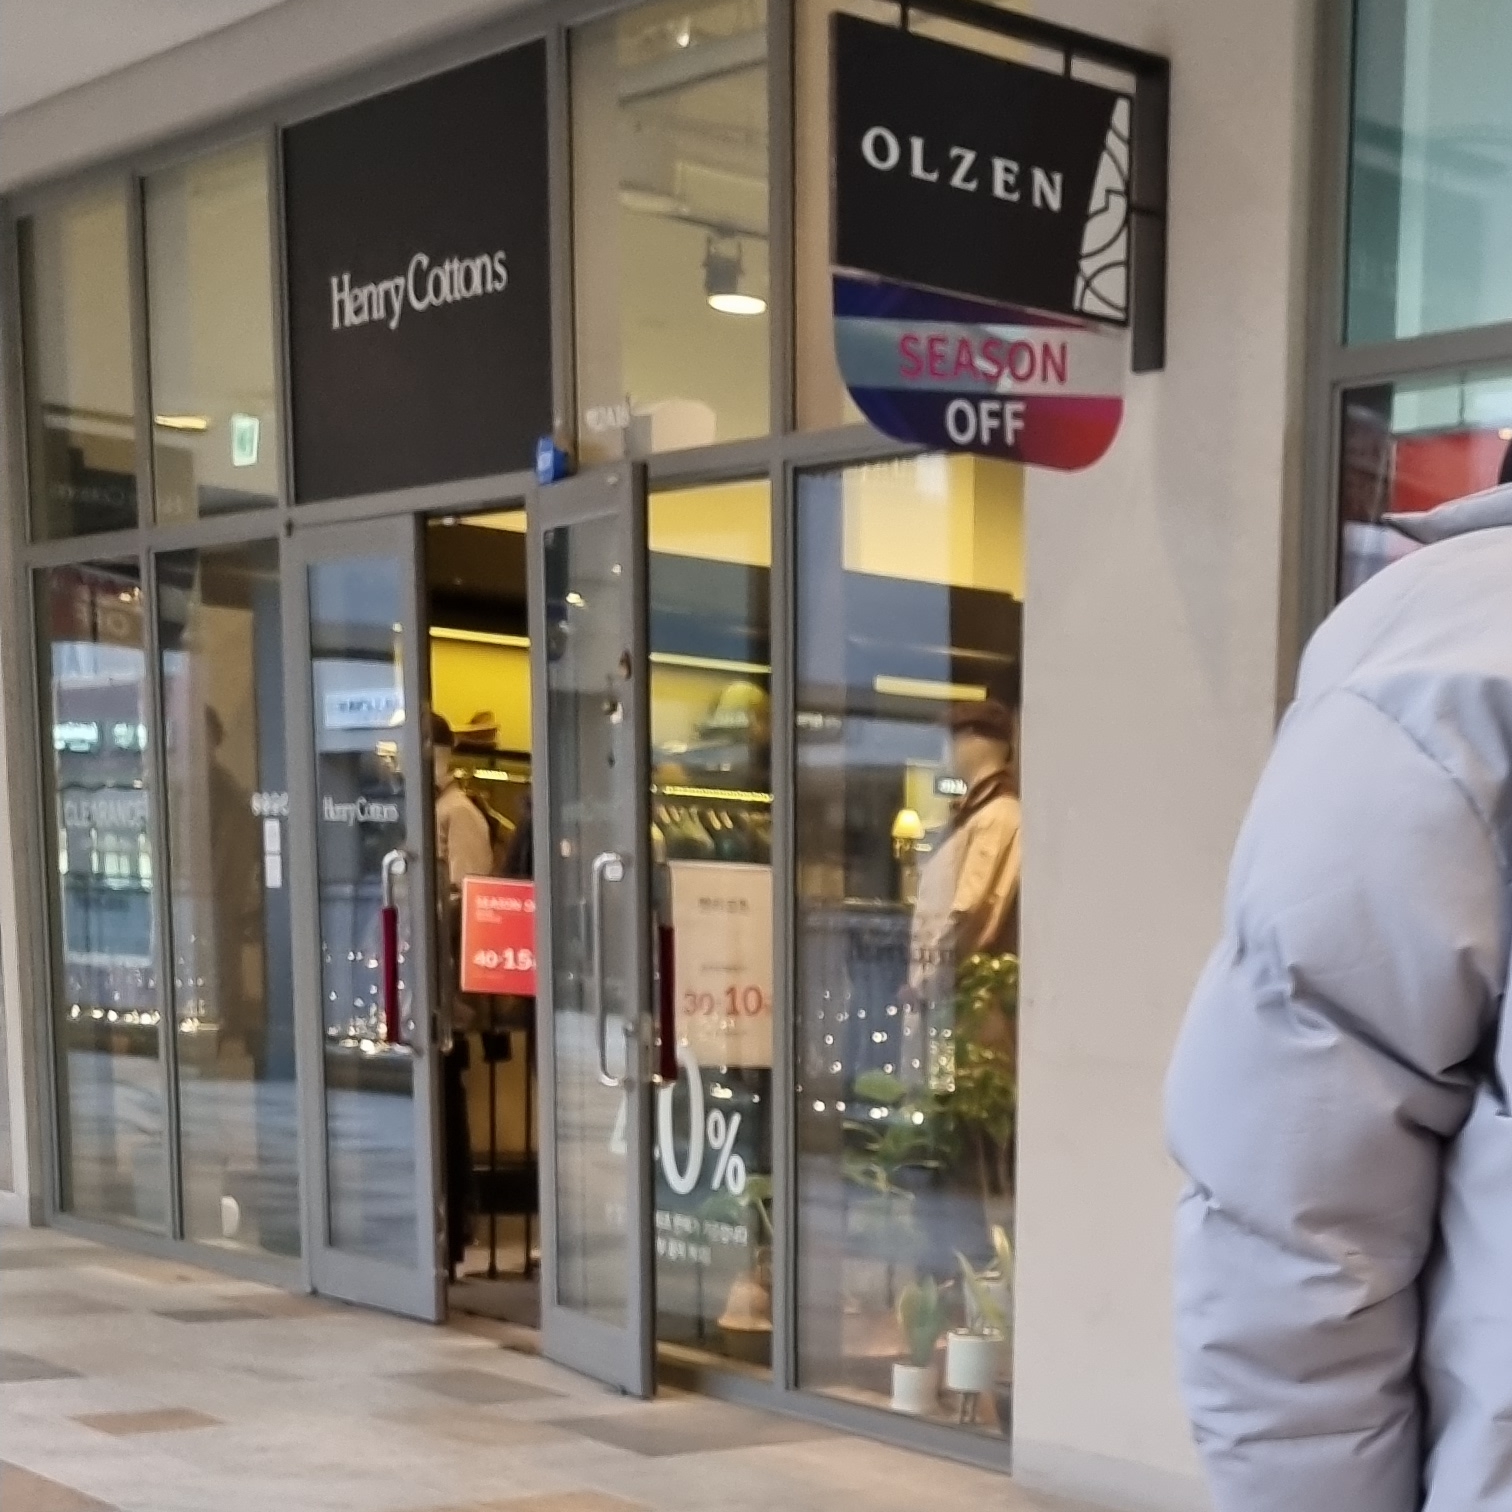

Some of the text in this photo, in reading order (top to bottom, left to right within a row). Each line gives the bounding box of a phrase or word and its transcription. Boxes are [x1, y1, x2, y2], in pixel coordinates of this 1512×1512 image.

[861, 125, 1064, 213] OLZEN
[330, 249, 509, 330] Henry Cottons
[898, 332, 1069, 385] SEASON
[945, 397, 1027, 447] OFF
